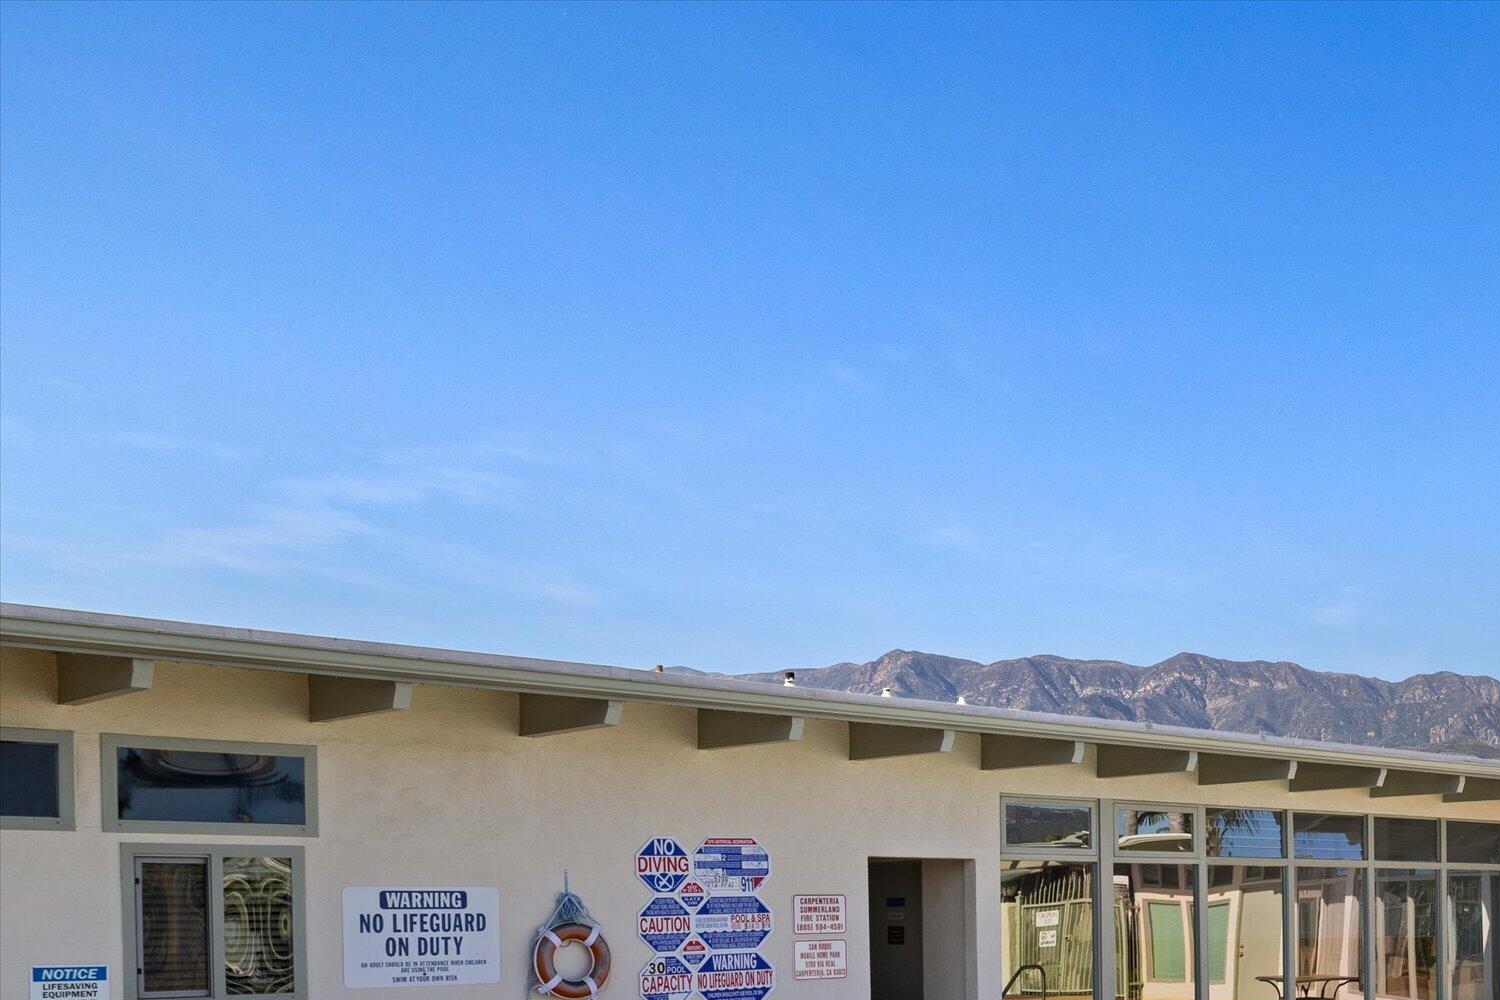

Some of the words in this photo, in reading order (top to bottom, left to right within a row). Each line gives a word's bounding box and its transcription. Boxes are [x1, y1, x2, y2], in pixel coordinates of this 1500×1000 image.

[653, 839, 675, 855] NO
[638, 857, 689, 873] DIVING
[741, 877, 754, 892] 911
[385, 892, 462, 908] WARNING
[800, 897, 839, 905] CARPENTERIA
[360, 913, 384, 933] NO
[392, 913, 487, 933] LIFEGUARD
[640, 916, 691, 933] CAUTION
[730, 914, 750, 923] POOL
[757, 913, 771, 922] SPA
[800, 914, 813, 922] FIRE
[385, 937, 409, 957] ON
[418, 936, 463, 956] DUTY
[649, 962, 665, 974] 30
[666, 965, 686, 974] POOL
[712, 953, 757, 971] WARNING
[41, 968, 98, 980] NOTICE
[697, 974, 708, 989] NO
[709, 972, 744, 989] LIFEGUARD
[745, 971, 755, 986] ON
[757, 970, 773, 985] DUTY
[42, 982, 98, 991] LIFESAVING
[642, 974, 692, 992] CAPACITY
[42, 990, 98, 999] EQUIPMENT
